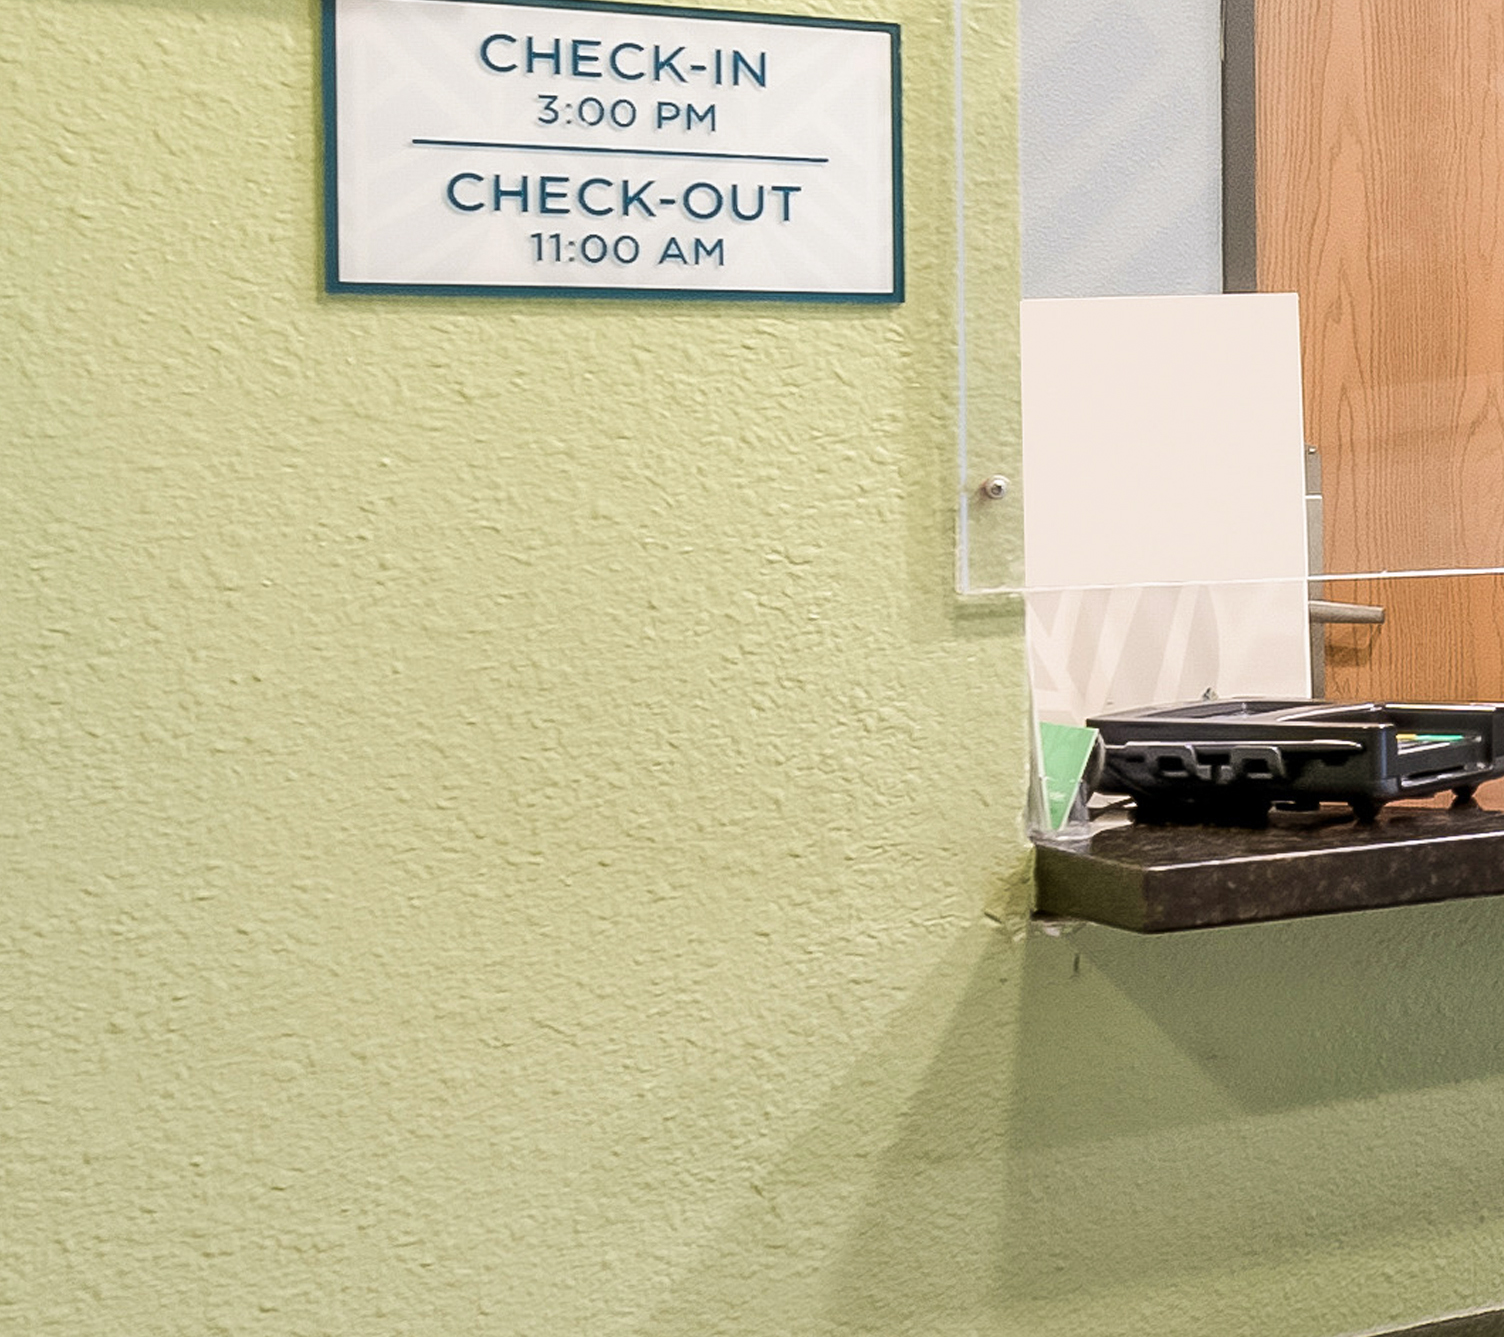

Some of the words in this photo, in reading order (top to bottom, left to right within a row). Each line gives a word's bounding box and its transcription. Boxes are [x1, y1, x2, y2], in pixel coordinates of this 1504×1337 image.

[480, 32, 767, 88] CHECK-IN
[537, 94, 637, 128] 3:00
[656, 101, 717, 132] PM
[446, 172, 802, 222] CHECK-OUT
[530, 232, 640, 264] 11:00
[657, 236, 725, 266] AM
